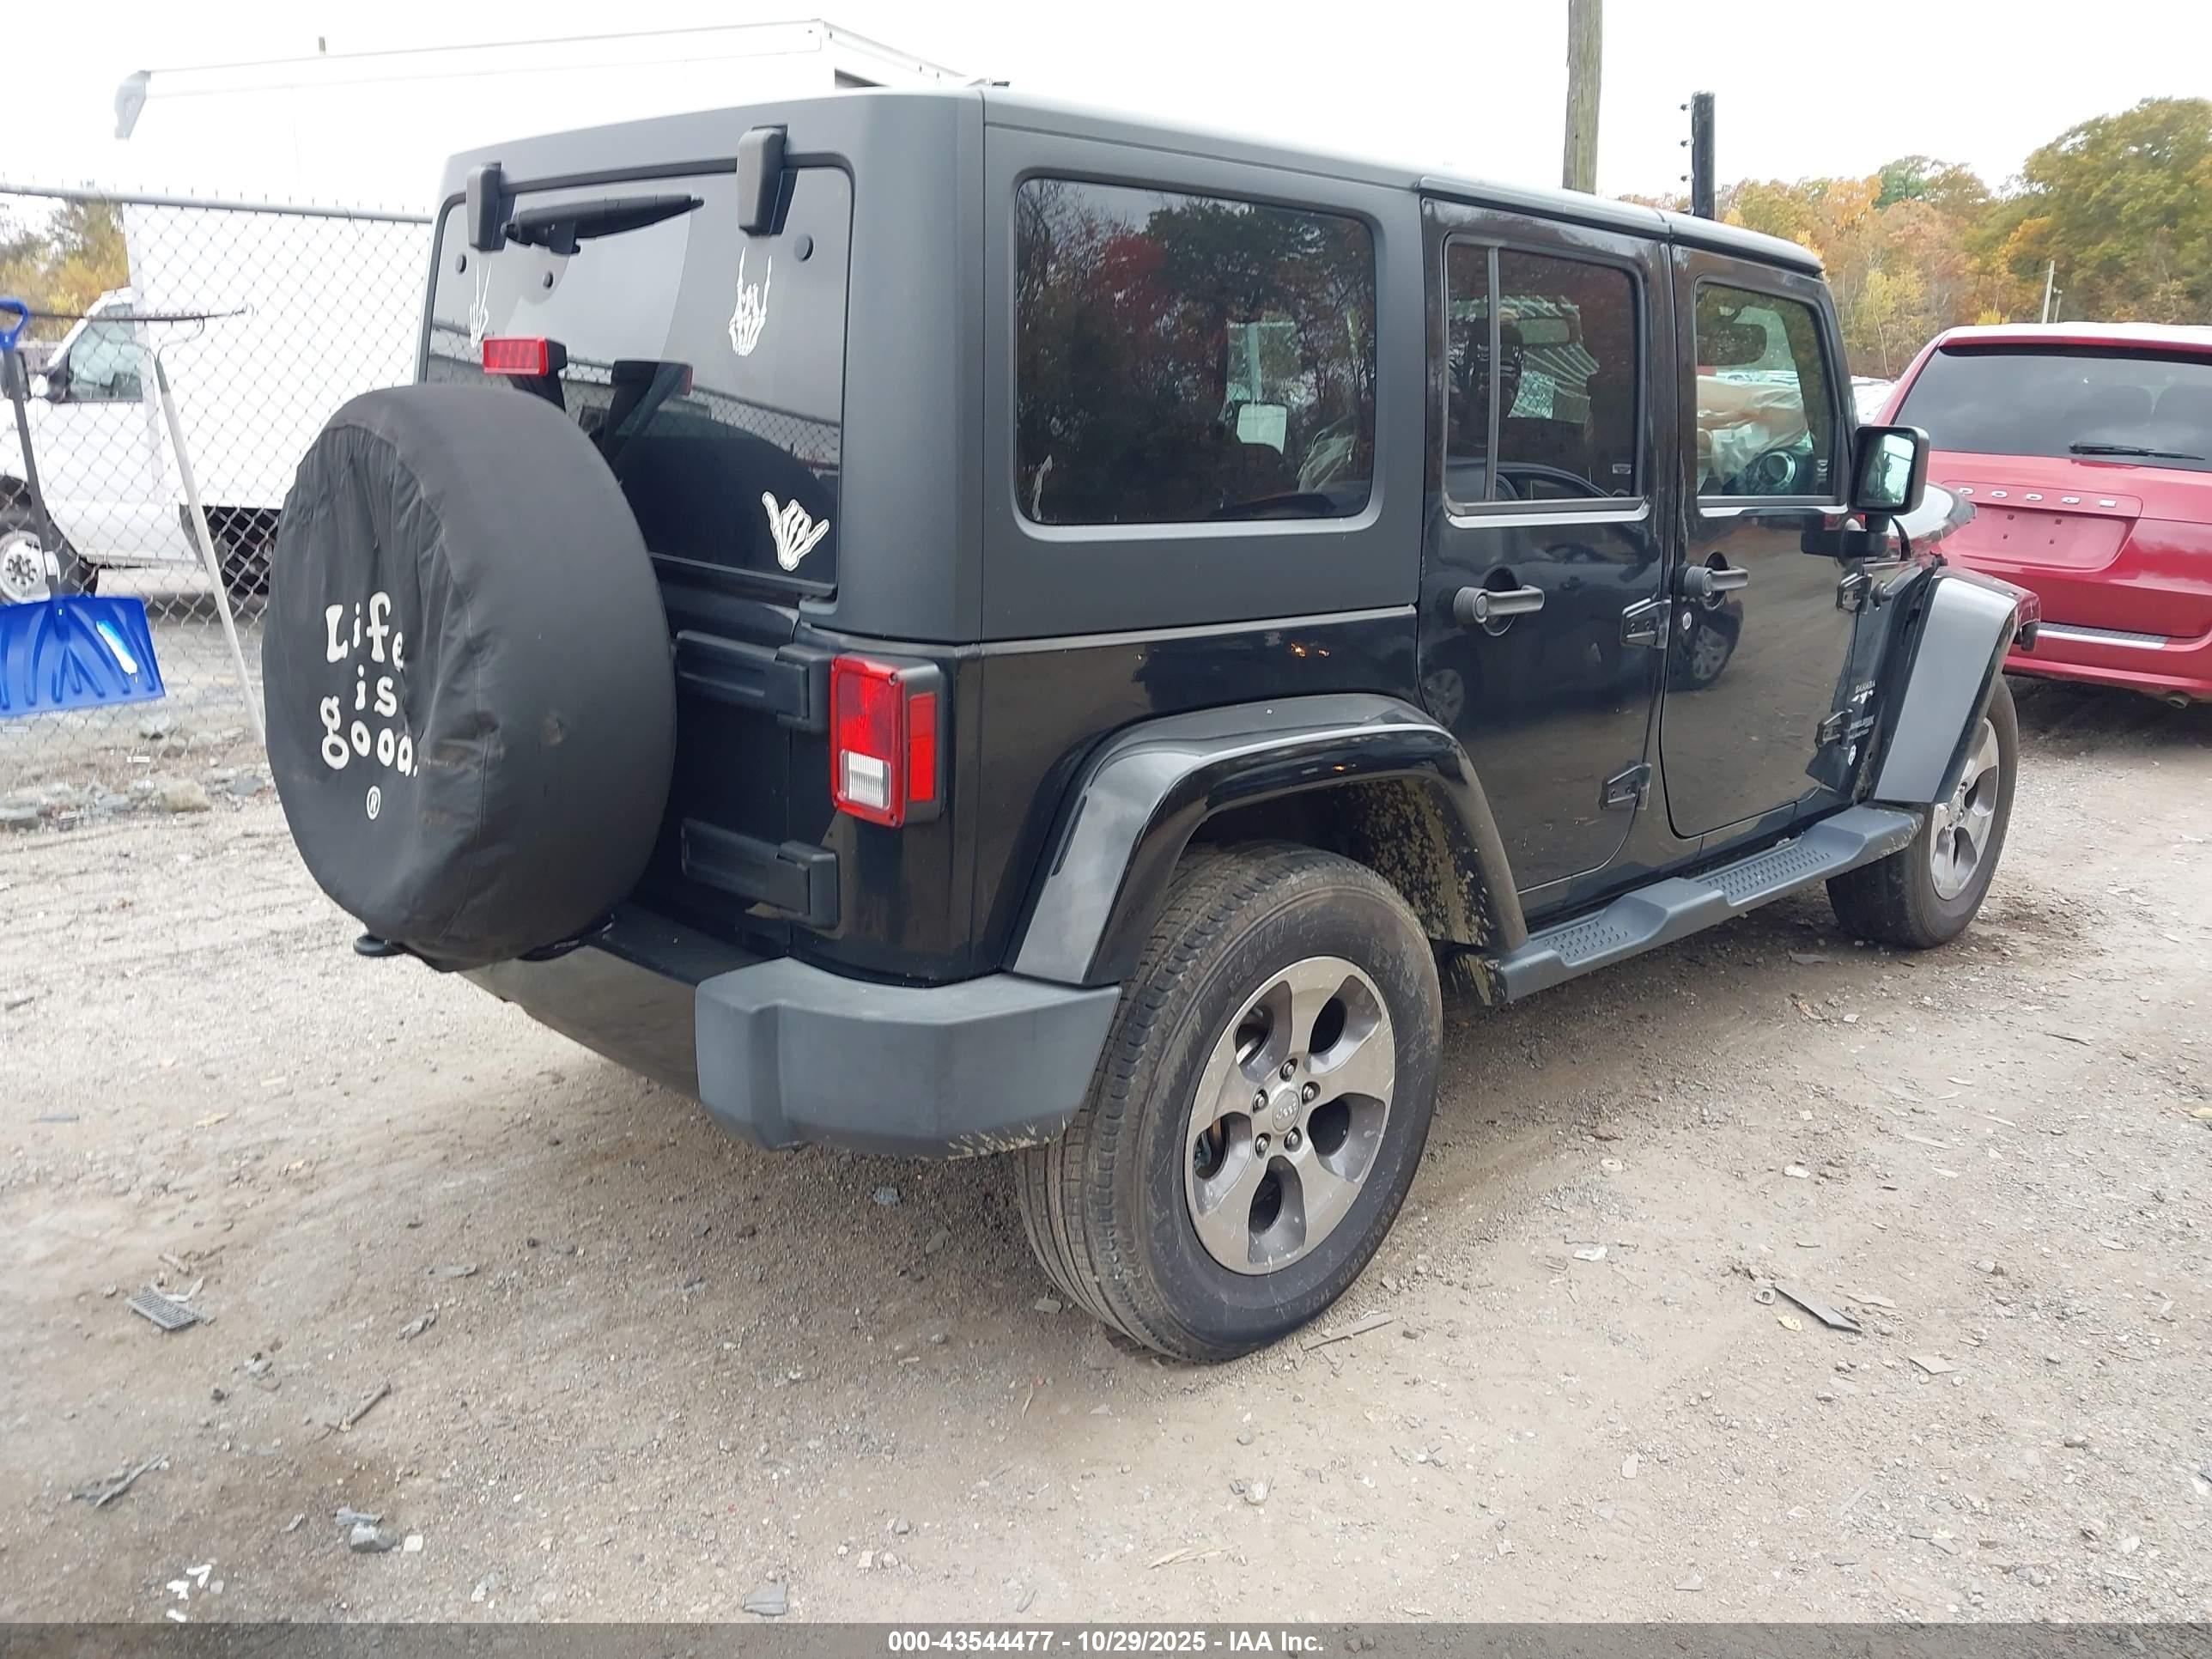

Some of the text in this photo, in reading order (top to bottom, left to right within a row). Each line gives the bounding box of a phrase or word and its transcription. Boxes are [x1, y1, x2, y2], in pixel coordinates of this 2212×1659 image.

[1959, 486, 2118, 508] DODGE
[325, 591, 404, 672] Life
[354, 665, 398, 718] is
